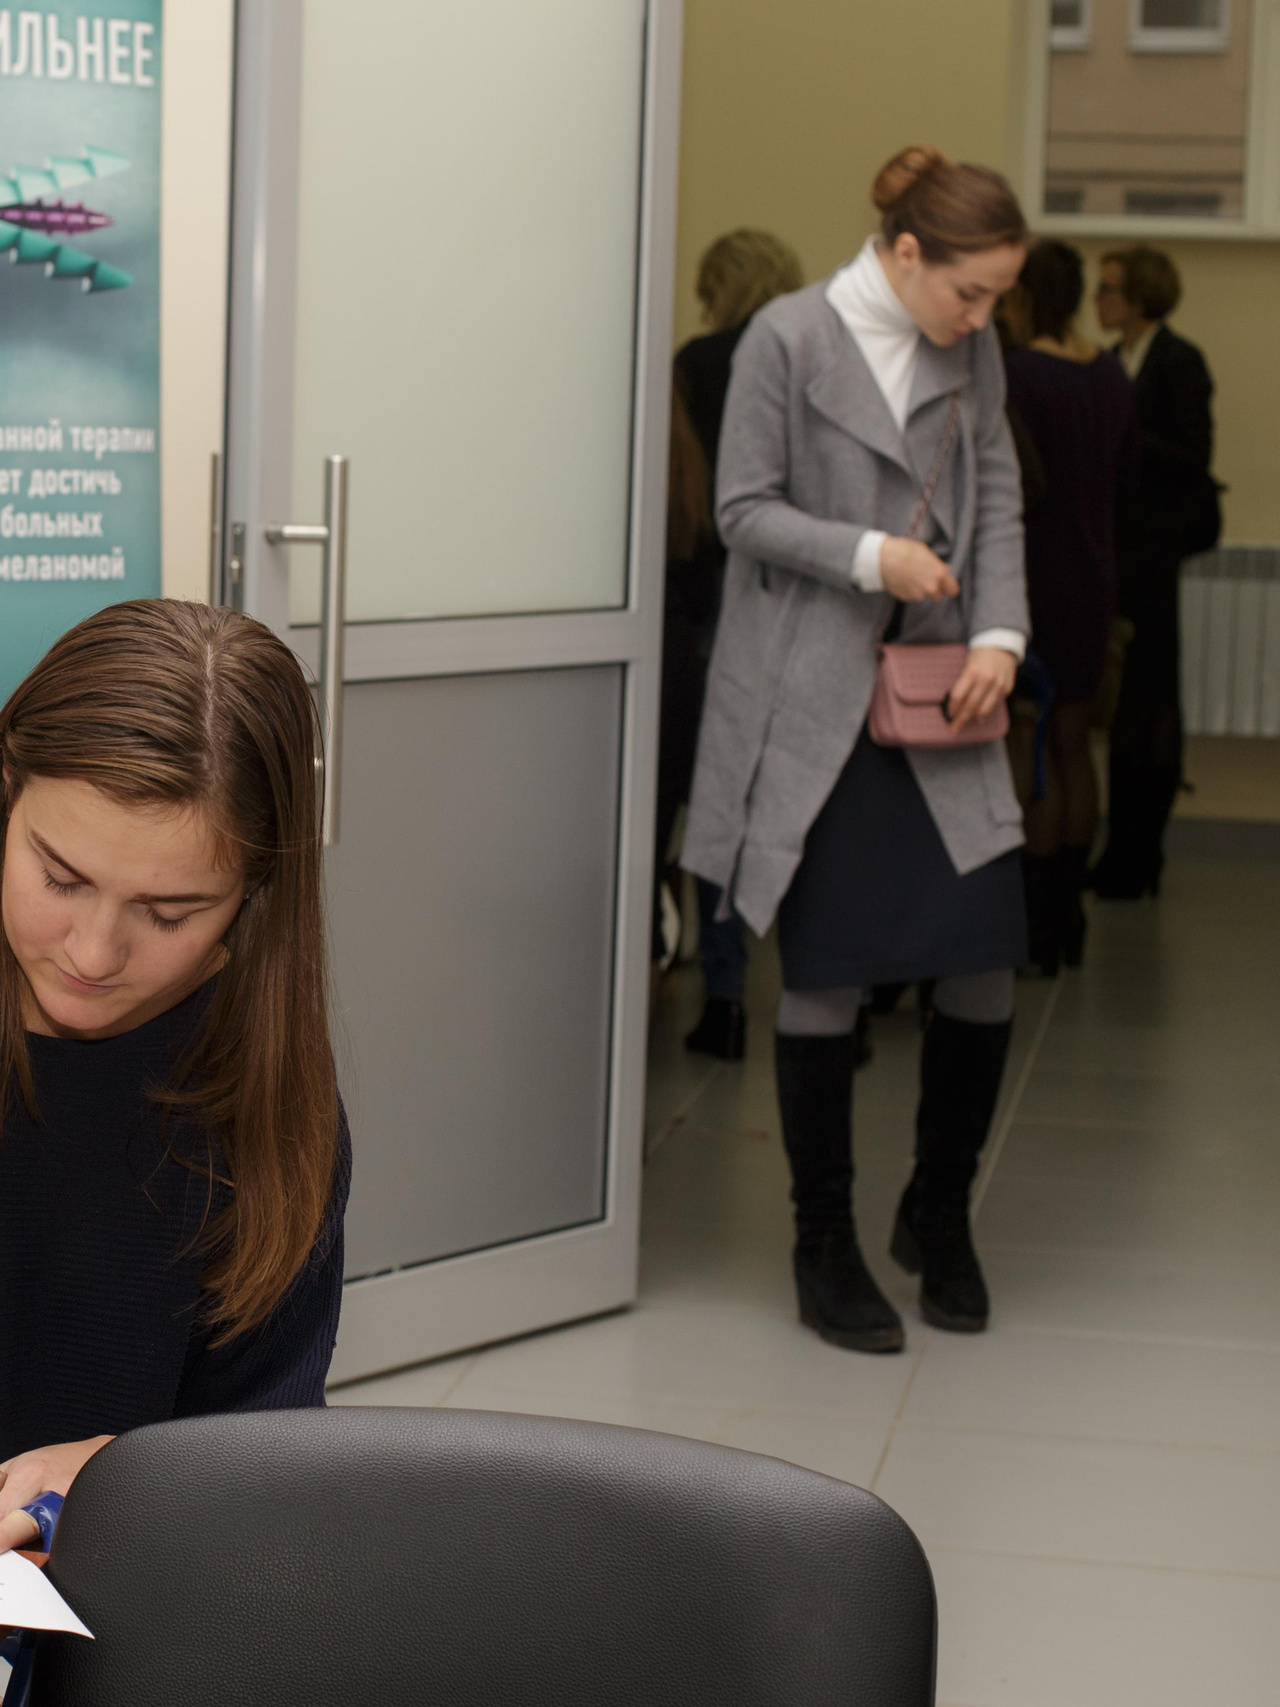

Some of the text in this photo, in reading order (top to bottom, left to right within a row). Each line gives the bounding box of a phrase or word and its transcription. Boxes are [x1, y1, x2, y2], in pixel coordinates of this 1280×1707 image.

[69, 425, 155, 461] терапии
[27, 468, 122, 498] достичь
[0, 503, 103, 539] больных
